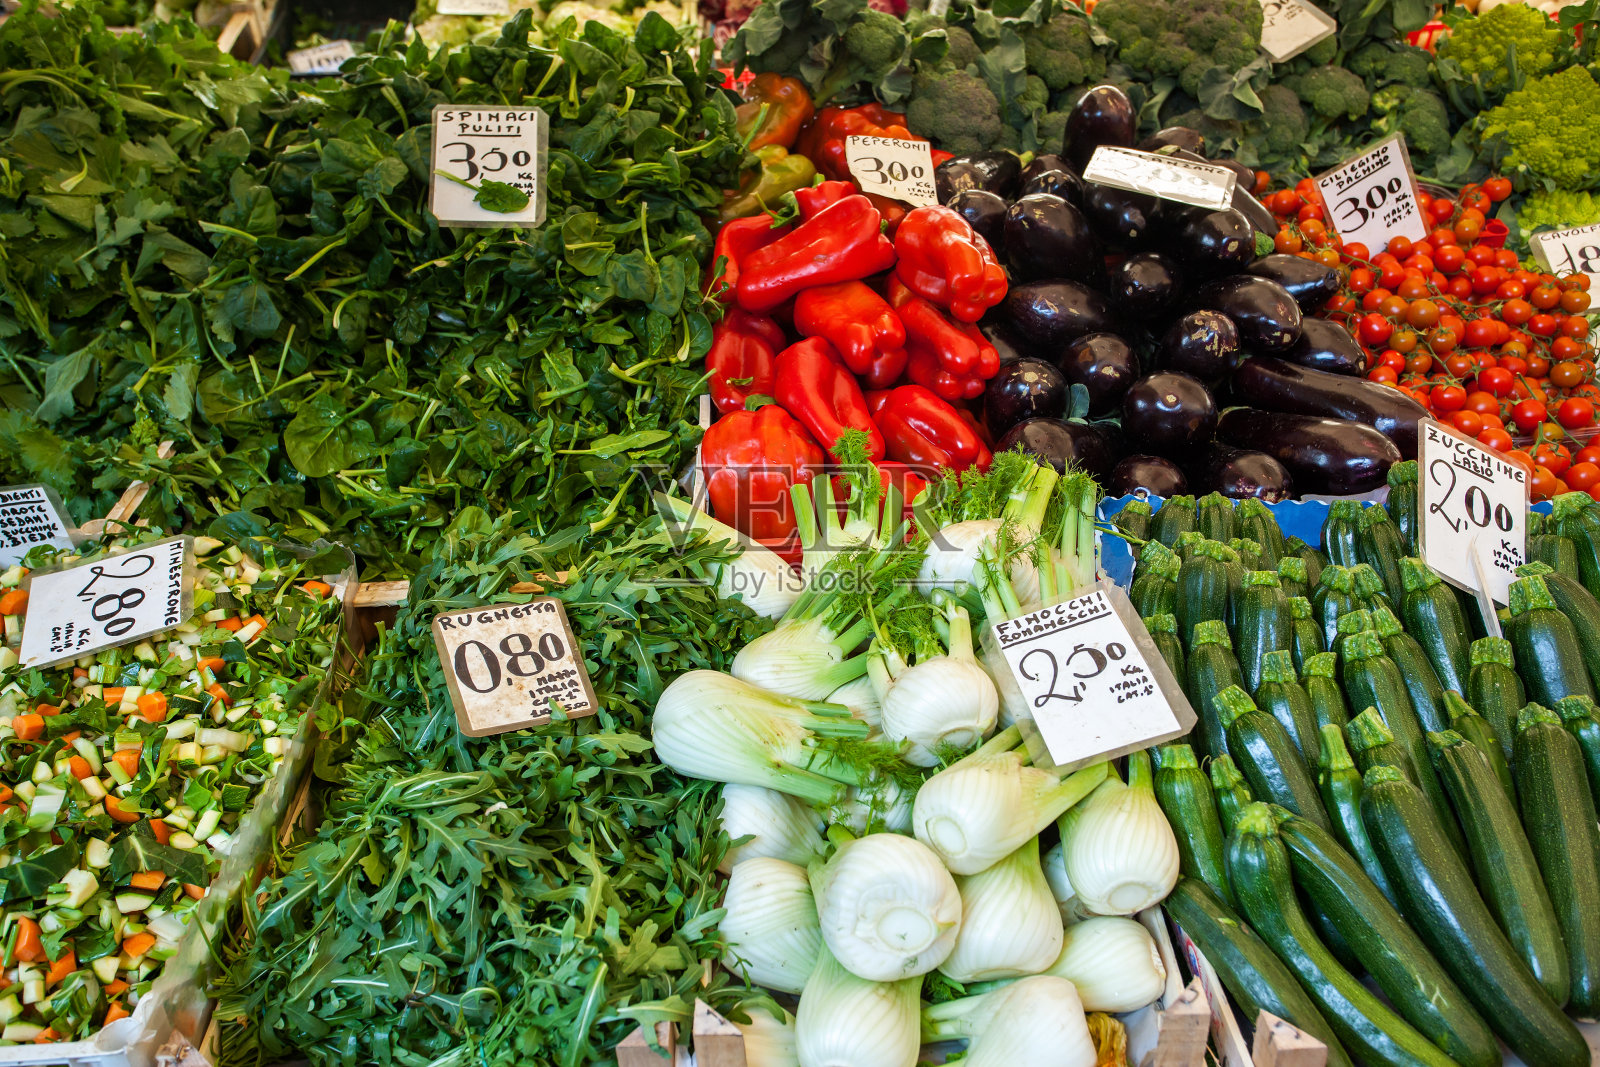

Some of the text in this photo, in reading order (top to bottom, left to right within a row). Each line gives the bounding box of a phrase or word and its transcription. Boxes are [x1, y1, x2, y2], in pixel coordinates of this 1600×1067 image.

[442, 111, 534, 122] SPINACI
[459, 123, 521, 134] PULITI
[442, 142, 531, 182] 3,50
[849, 136, 926, 151] PEPERONI
[853, 157, 924, 185] 3,00
[1321, 146, 1389, 188] CILIEGINO
[1336, 155, 1390, 189] PACHINO
[908, 187, 935, 195] ITALIA
[1334, 177, 1402, 233] 3,00
[1427, 426, 1524, 484] ZUCCHINE
[1453, 453, 1493, 478] LAZIO
[1430, 459, 1514, 533] 2,00
[77, 555, 154, 636] 2,80
[164, 541, 183, 626] MINESTRONE
[438, 602, 556, 631] RUGHETTA
[996, 592, 1103, 635] FINOCCHI
[999, 603, 1108, 644] ROMANESCHI
[454, 633, 565, 694] 0,80
[1019, 642, 1127, 708] 2,50
[529, 679, 579, 698] ITALIA
[1109, 675, 1148, 693] ITALIA
